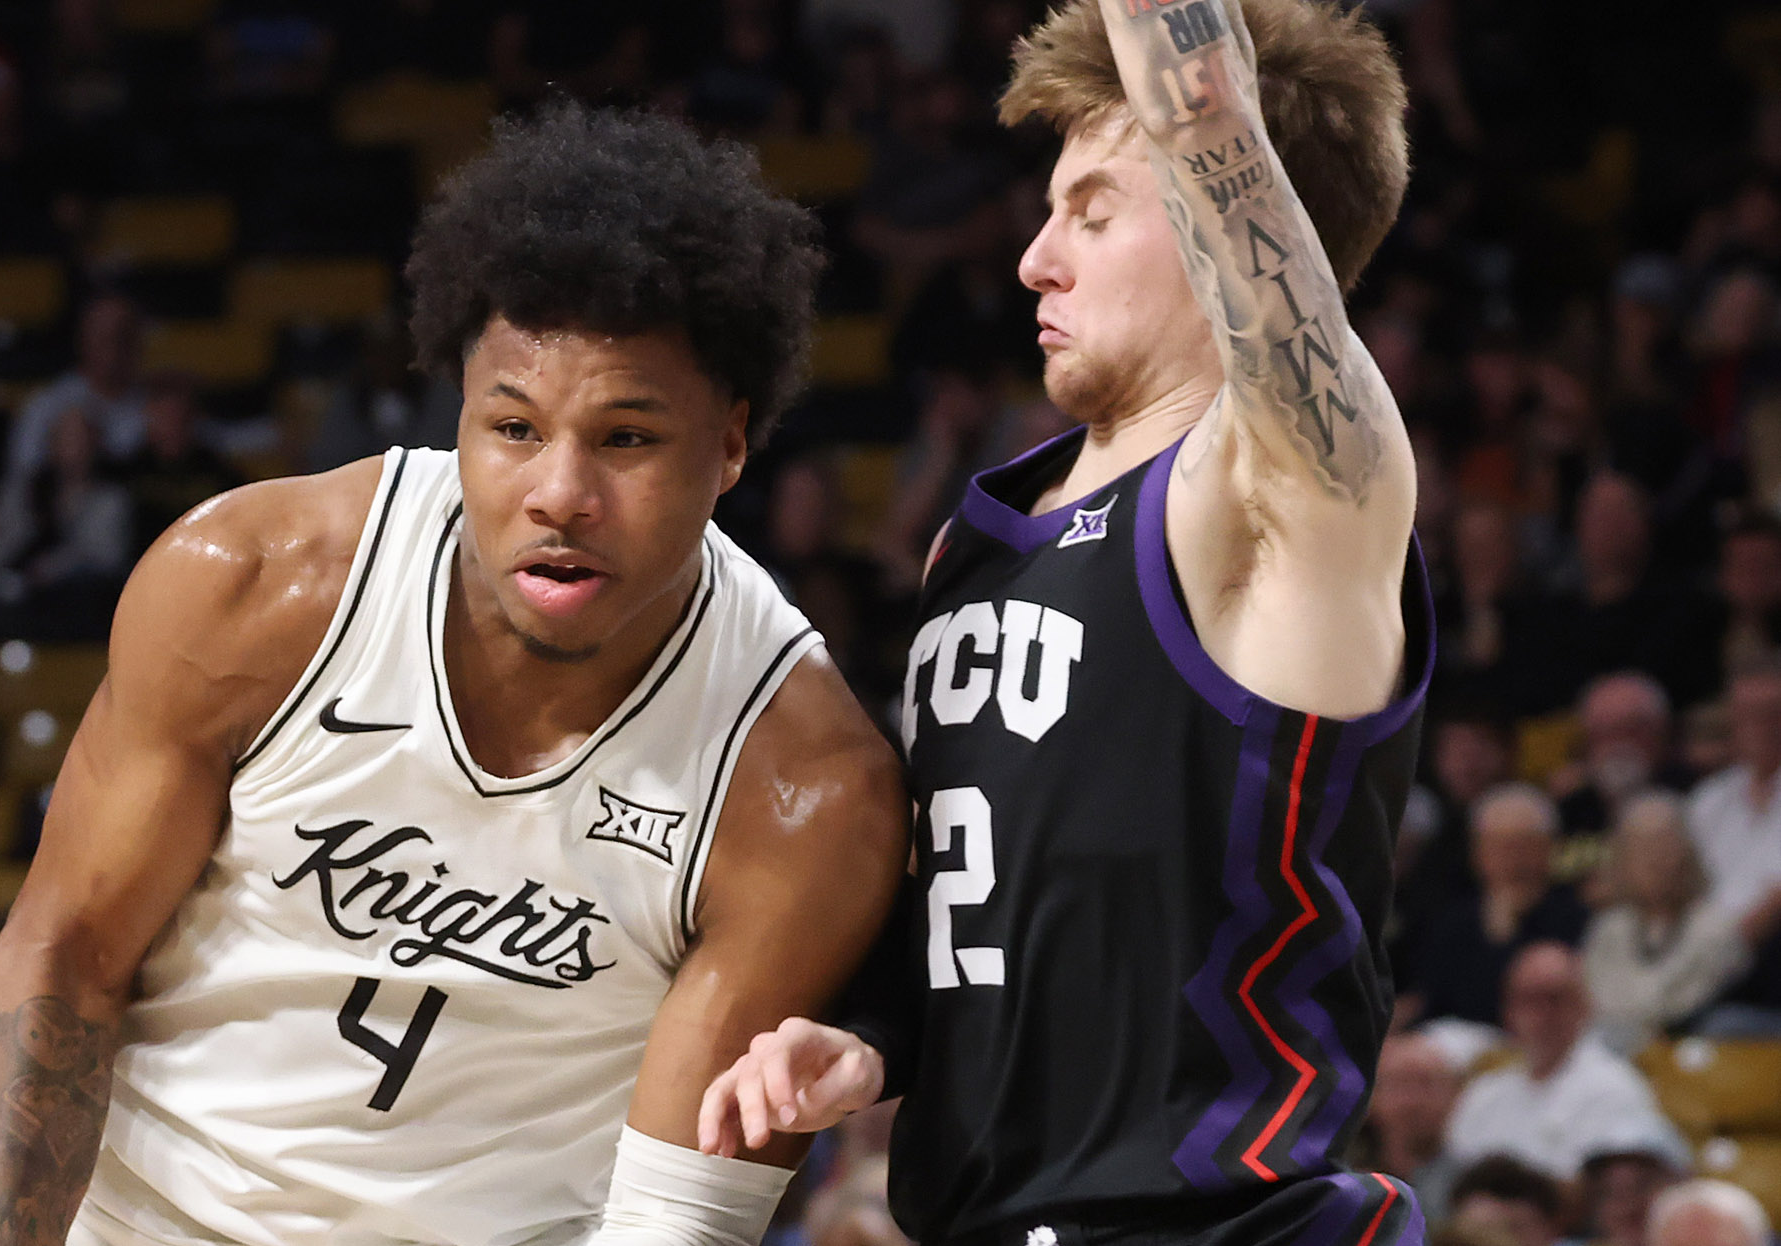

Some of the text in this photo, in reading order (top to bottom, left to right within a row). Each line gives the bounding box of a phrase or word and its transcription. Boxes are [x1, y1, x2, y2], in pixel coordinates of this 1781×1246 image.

[901, 599, 1085, 766] TCU
[589, 789, 683, 862] XII
[272, 820, 618, 988] Knights
[337, 976, 449, 1112] 4
